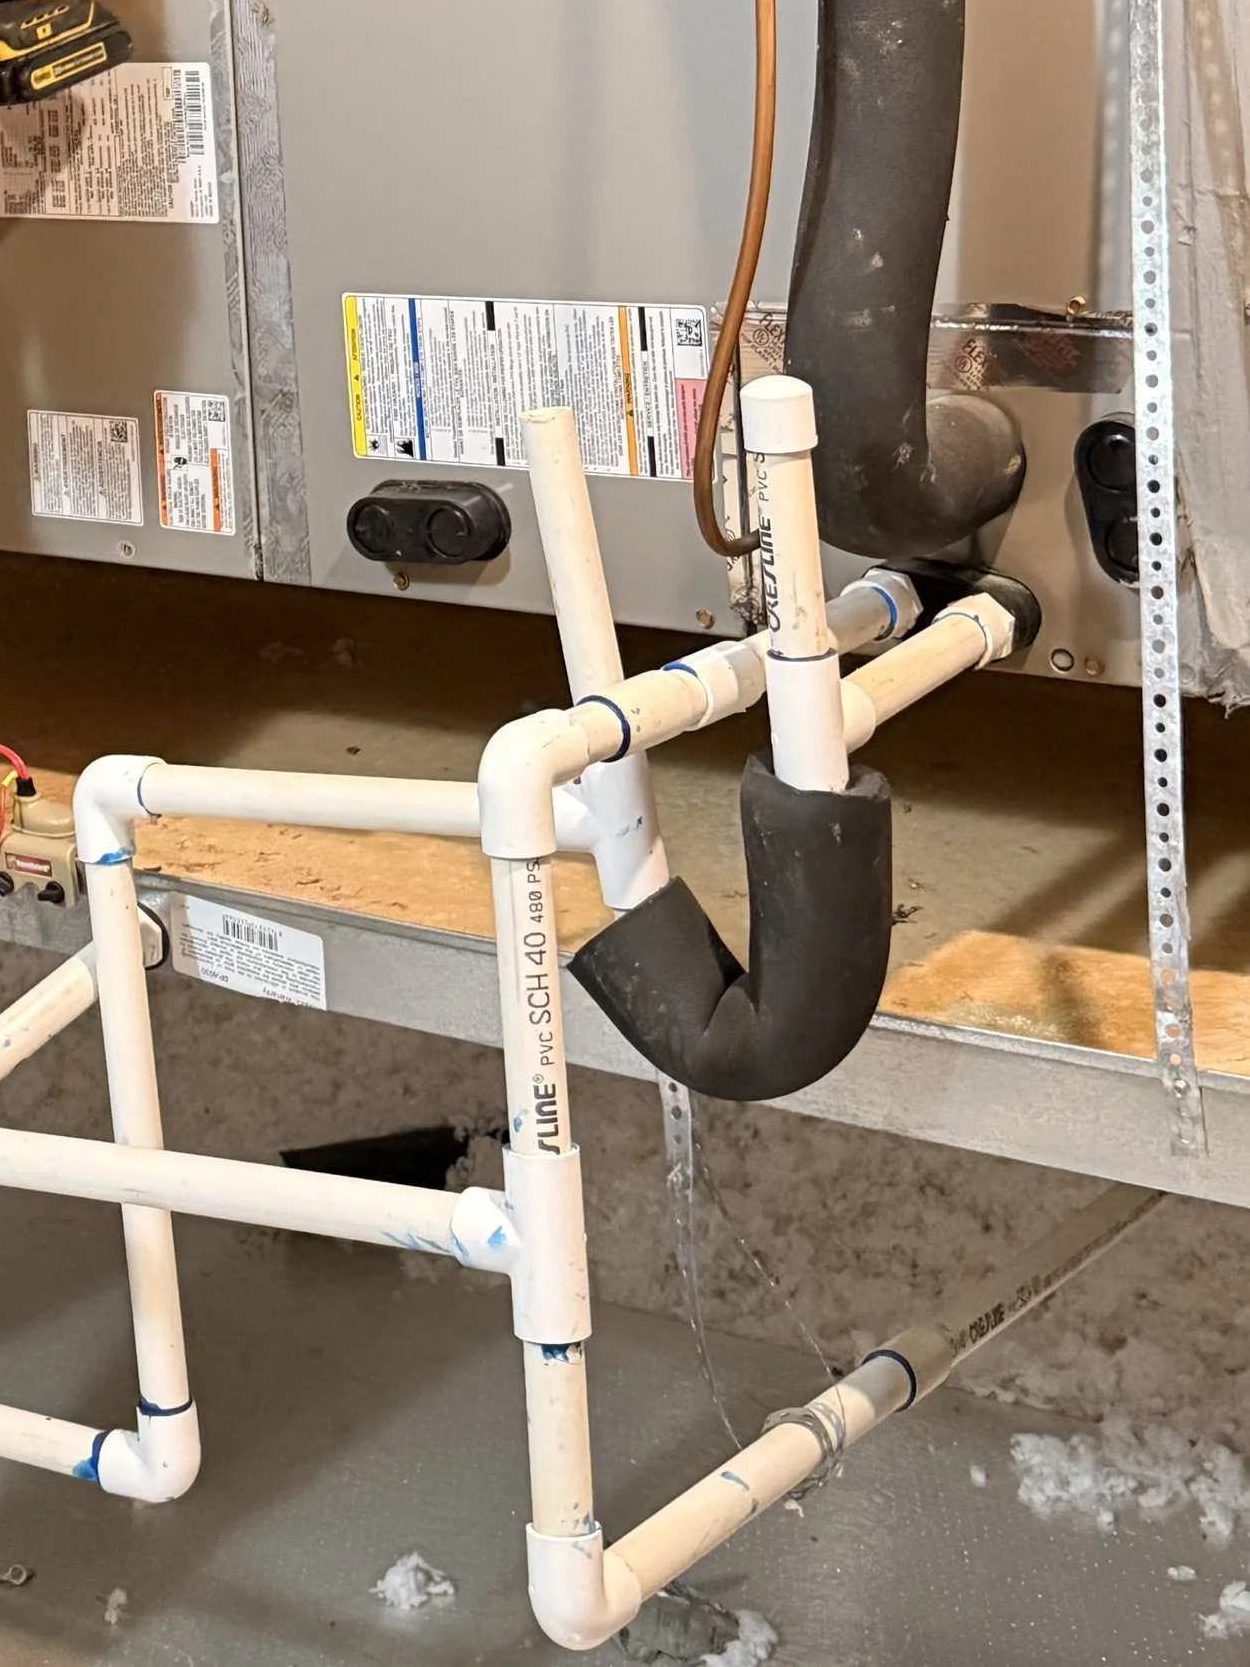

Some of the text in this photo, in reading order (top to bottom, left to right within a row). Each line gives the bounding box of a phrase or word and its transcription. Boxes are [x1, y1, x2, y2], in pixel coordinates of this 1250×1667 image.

[758, 469, 770, 502] PVC
[758, 515, 782, 633] CRESLINE
[526, 857, 542, 885] PS
[528, 890, 543, 924] 480
[523, 931, 547, 966] 40
[527, 972, 551, 1025] SCH
[539, 1031, 554, 1067] PVC
